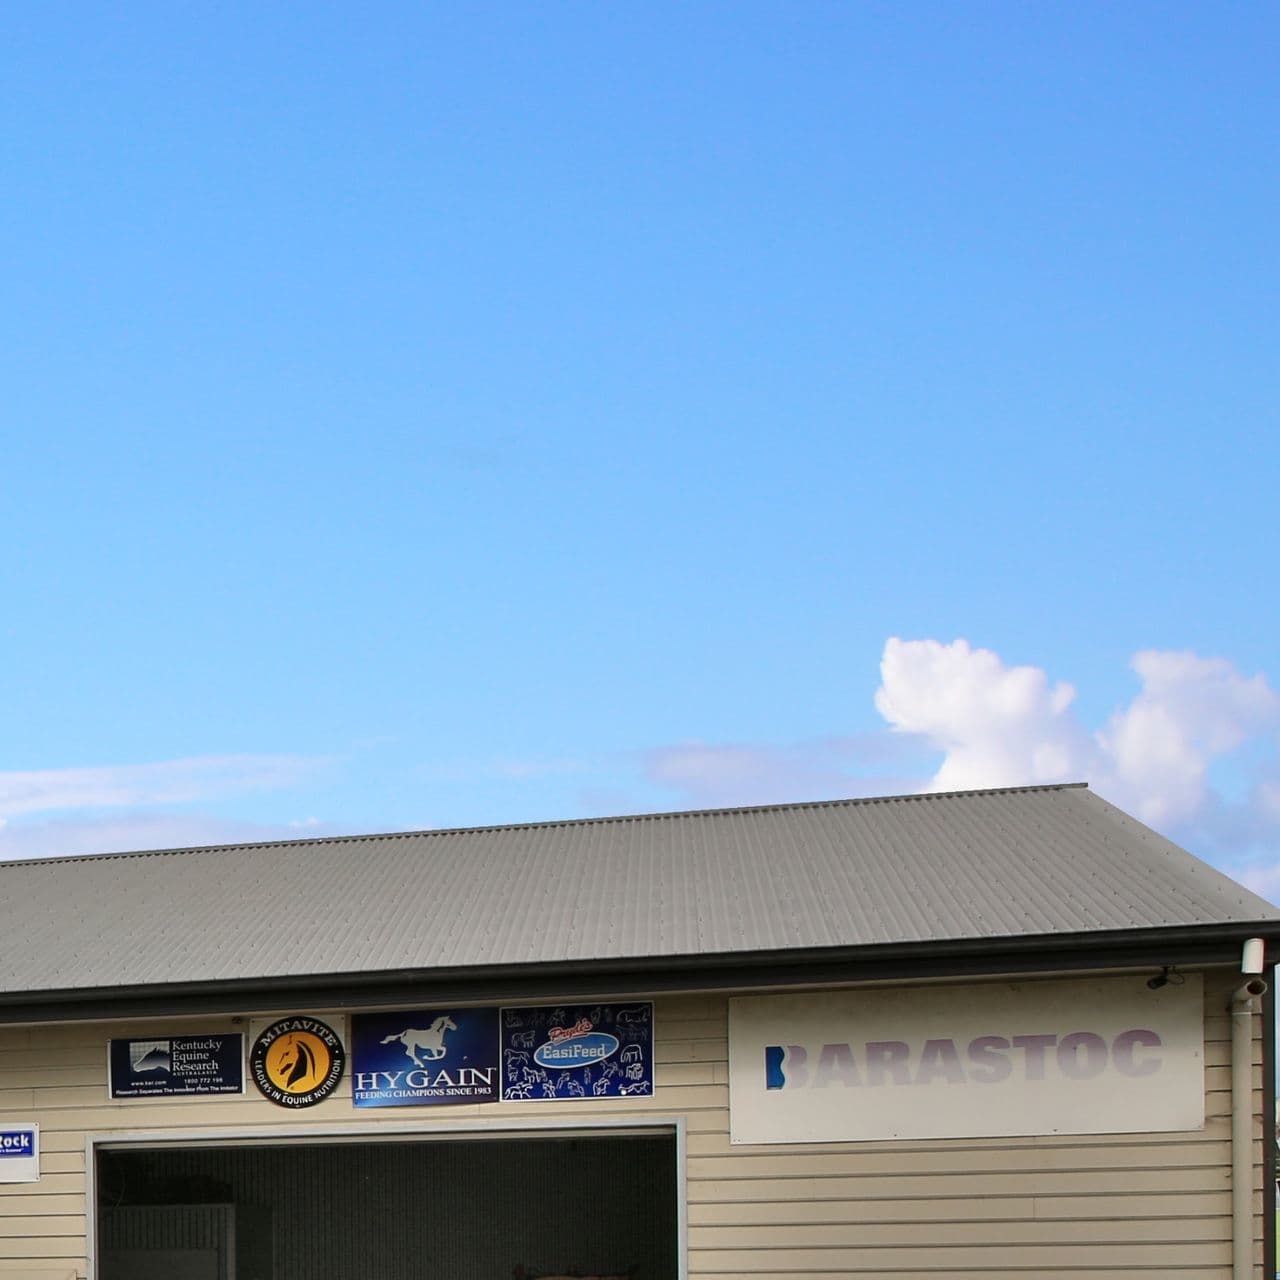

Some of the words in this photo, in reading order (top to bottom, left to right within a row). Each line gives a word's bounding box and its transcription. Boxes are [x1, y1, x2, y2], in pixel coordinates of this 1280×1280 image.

[261, 1020, 336, 1047] MITAVITE
[172, 1040, 222, 1052] Kentucky
[543, 1043, 606, 1059] EasiFeed
[172, 1051, 210, 1063] Equine
[764, 1029, 1163, 1091] BARASTOC
[172, 1060, 219, 1072] Research
[255, 1060, 272, 1093] LEADERS
[271, 1090, 282, 1100] IN
[281, 1095, 314, 1105] EQUINE
[313, 1059, 342, 1098] NUTRITION
[354, 1067, 497, 1091] HYGAIN
[355, 1090, 392, 1100] FEEDING
[393, 1088, 445, 1098] CHAMPIONS
[445, 1087, 473, 1096] SINCE
[474, 1087, 492, 1095] 1983
